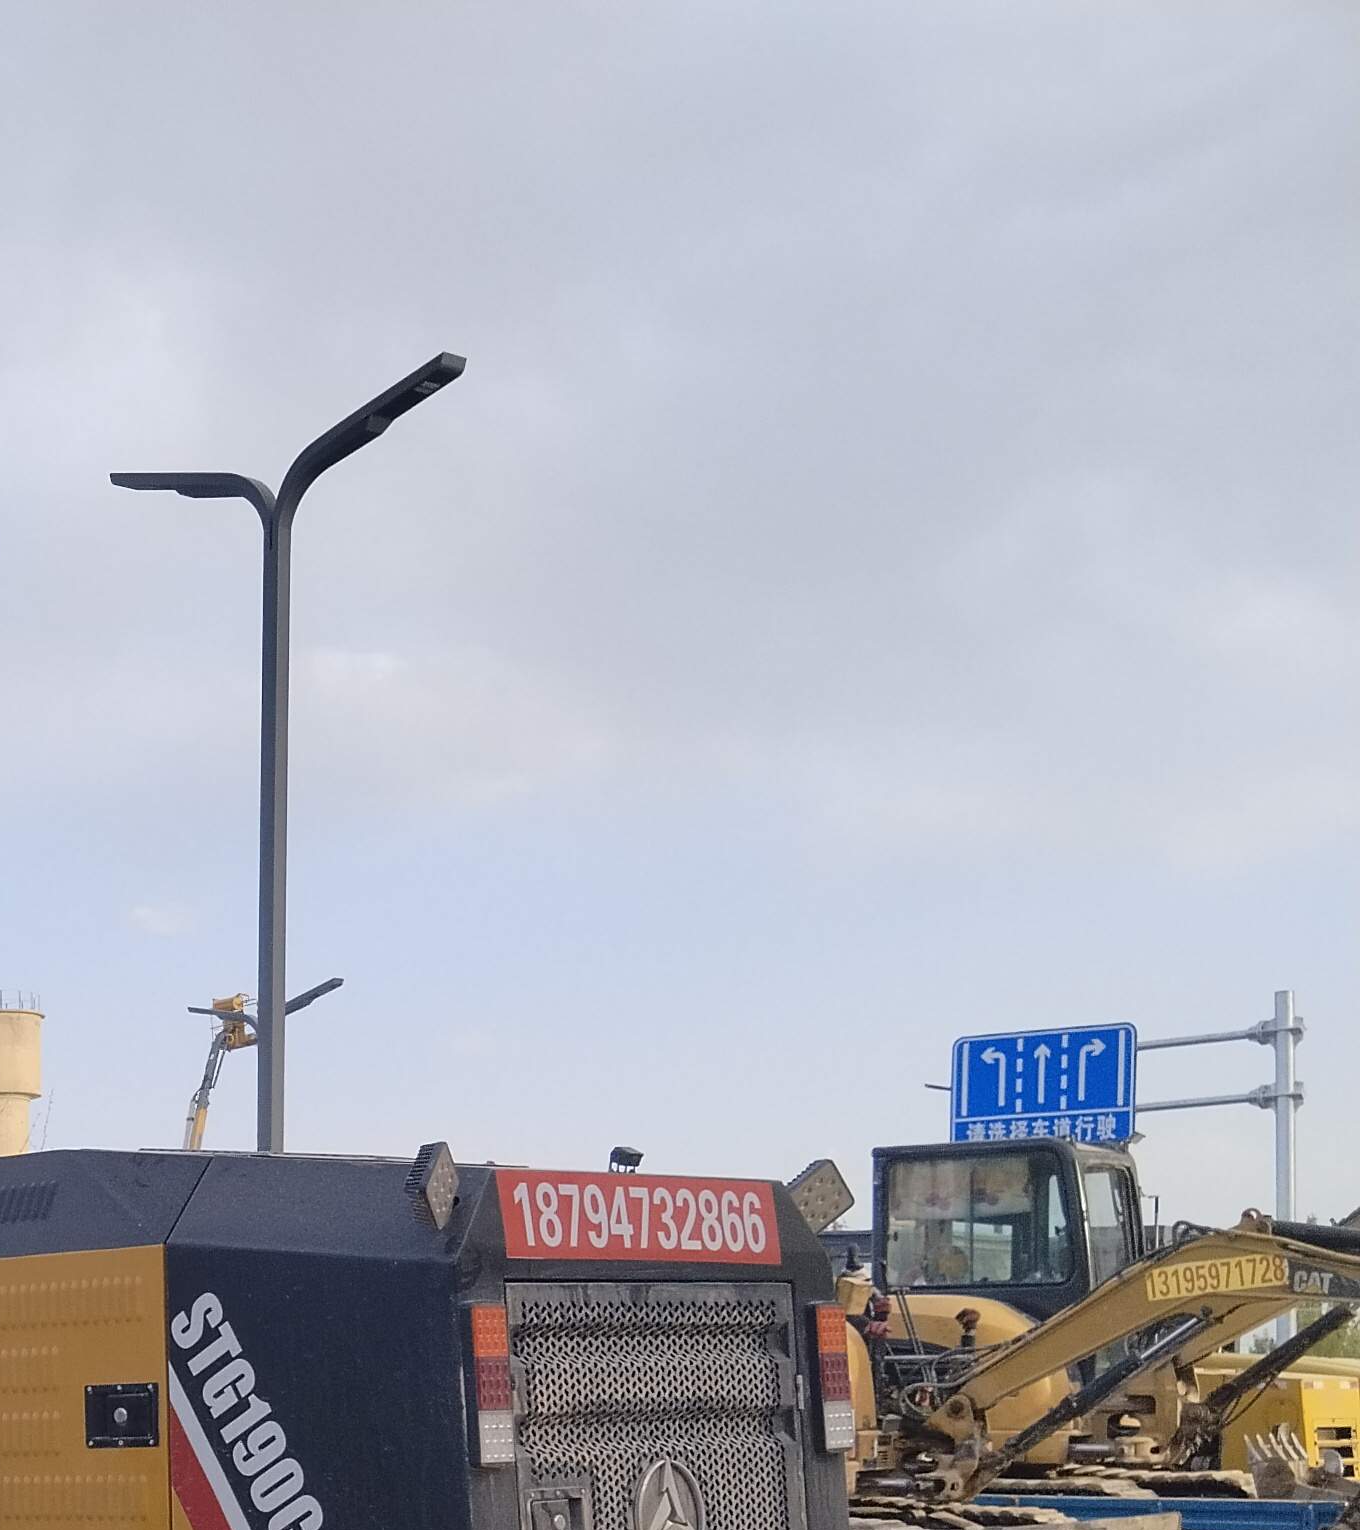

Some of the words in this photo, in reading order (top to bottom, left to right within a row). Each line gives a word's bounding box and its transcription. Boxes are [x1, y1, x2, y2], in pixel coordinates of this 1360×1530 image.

[966, 1112, 1117, 1142] 请选择车道行驶
[512, 1180, 767, 1254] 18794732866
[1147, 1255, 1286, 1299] 13195971728
[1293, 1270, 1334, 1295] CAT
